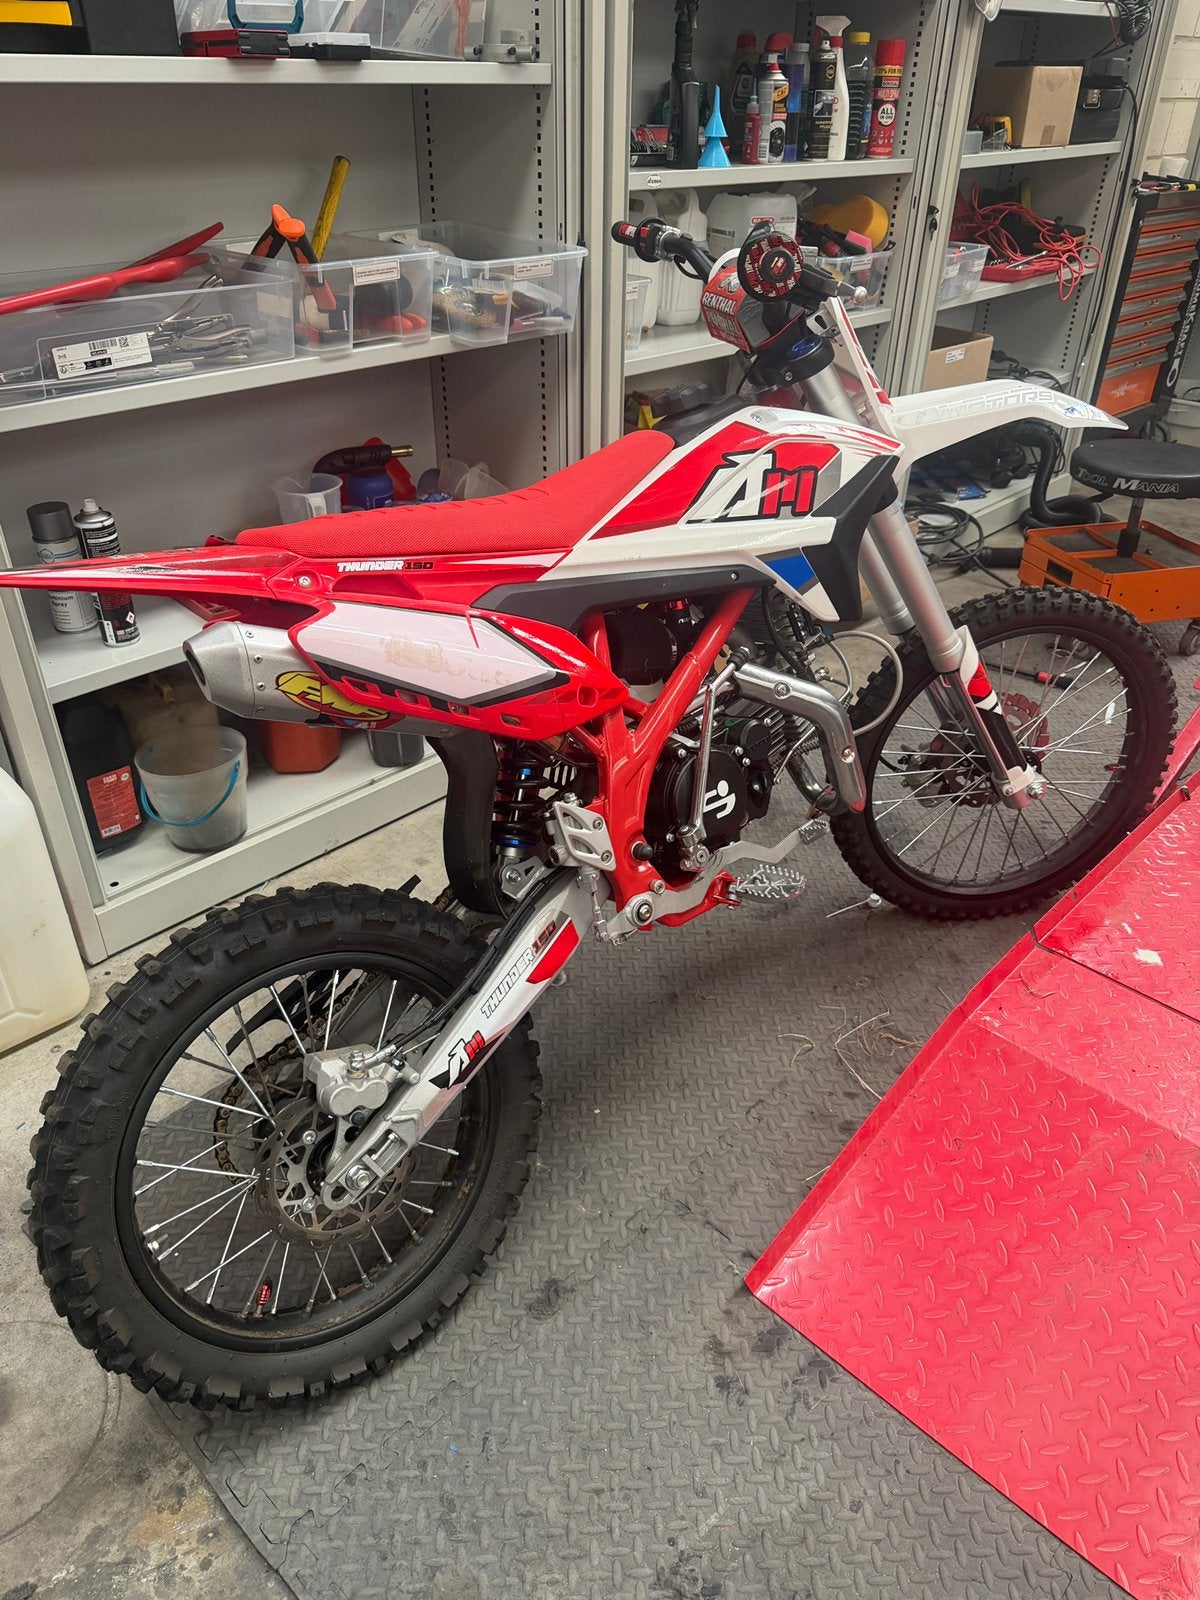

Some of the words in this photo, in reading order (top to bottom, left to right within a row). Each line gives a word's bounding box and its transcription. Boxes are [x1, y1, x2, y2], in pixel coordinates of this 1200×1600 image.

[880, 107, 894, 115] ALL
[702, 292, 736, 315] RENTHAL
[1078, 467, 1109, 487] TOOL
[1112, 477, 1180, 495] MANIA
[336, 560, 405, 573] THUNDER
[405, 561, 434, 571] 150
[480, 947, 535, 1019] THUNDER
[532, 919, 557, 954] 150
